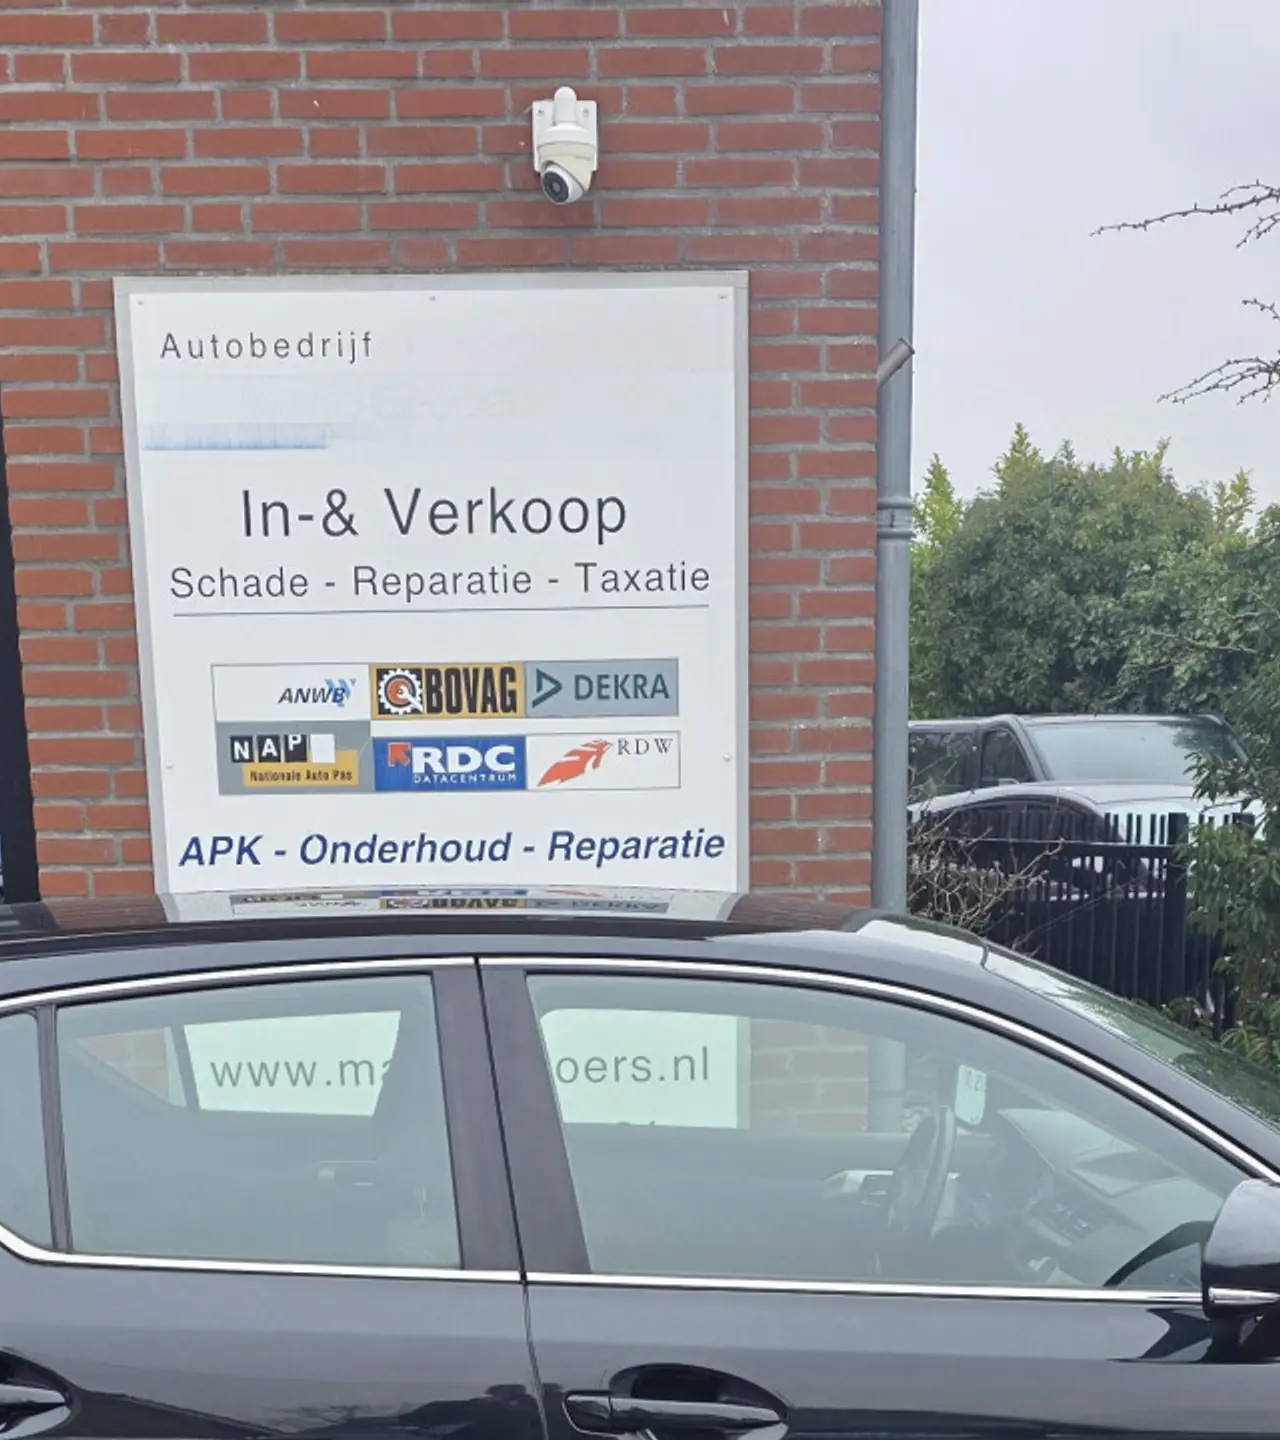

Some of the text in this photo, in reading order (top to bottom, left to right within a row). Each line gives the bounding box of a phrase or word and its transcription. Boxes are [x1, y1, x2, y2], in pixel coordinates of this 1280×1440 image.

[160, 330, 373, 365] Autobedrijf
[242, 486, 627, 546] In-& Verkoop
[170, 566, 309, 599] Schade
[353, 563, 532, 604] Reparatie
[574, 560, 710, 593] Taxatie
[277, 687, 347, 704] ANWB
[424, 665, 518, 715] BOVAG
[573, 673, 670, 701] DEKRA
[232, 733, 303, 761] NAP
[411, 745, 516, 774] RDC
[617, 737, 674, 756] RDW
[249, 770, 302, 783] Nationale
[412, 773, 518, 784] DATACENTRUM
[178, 834, 263, 868] APK
[300, 831, 513, 866] Onderhoud
[547, 827, 725, 869] Reparatie
